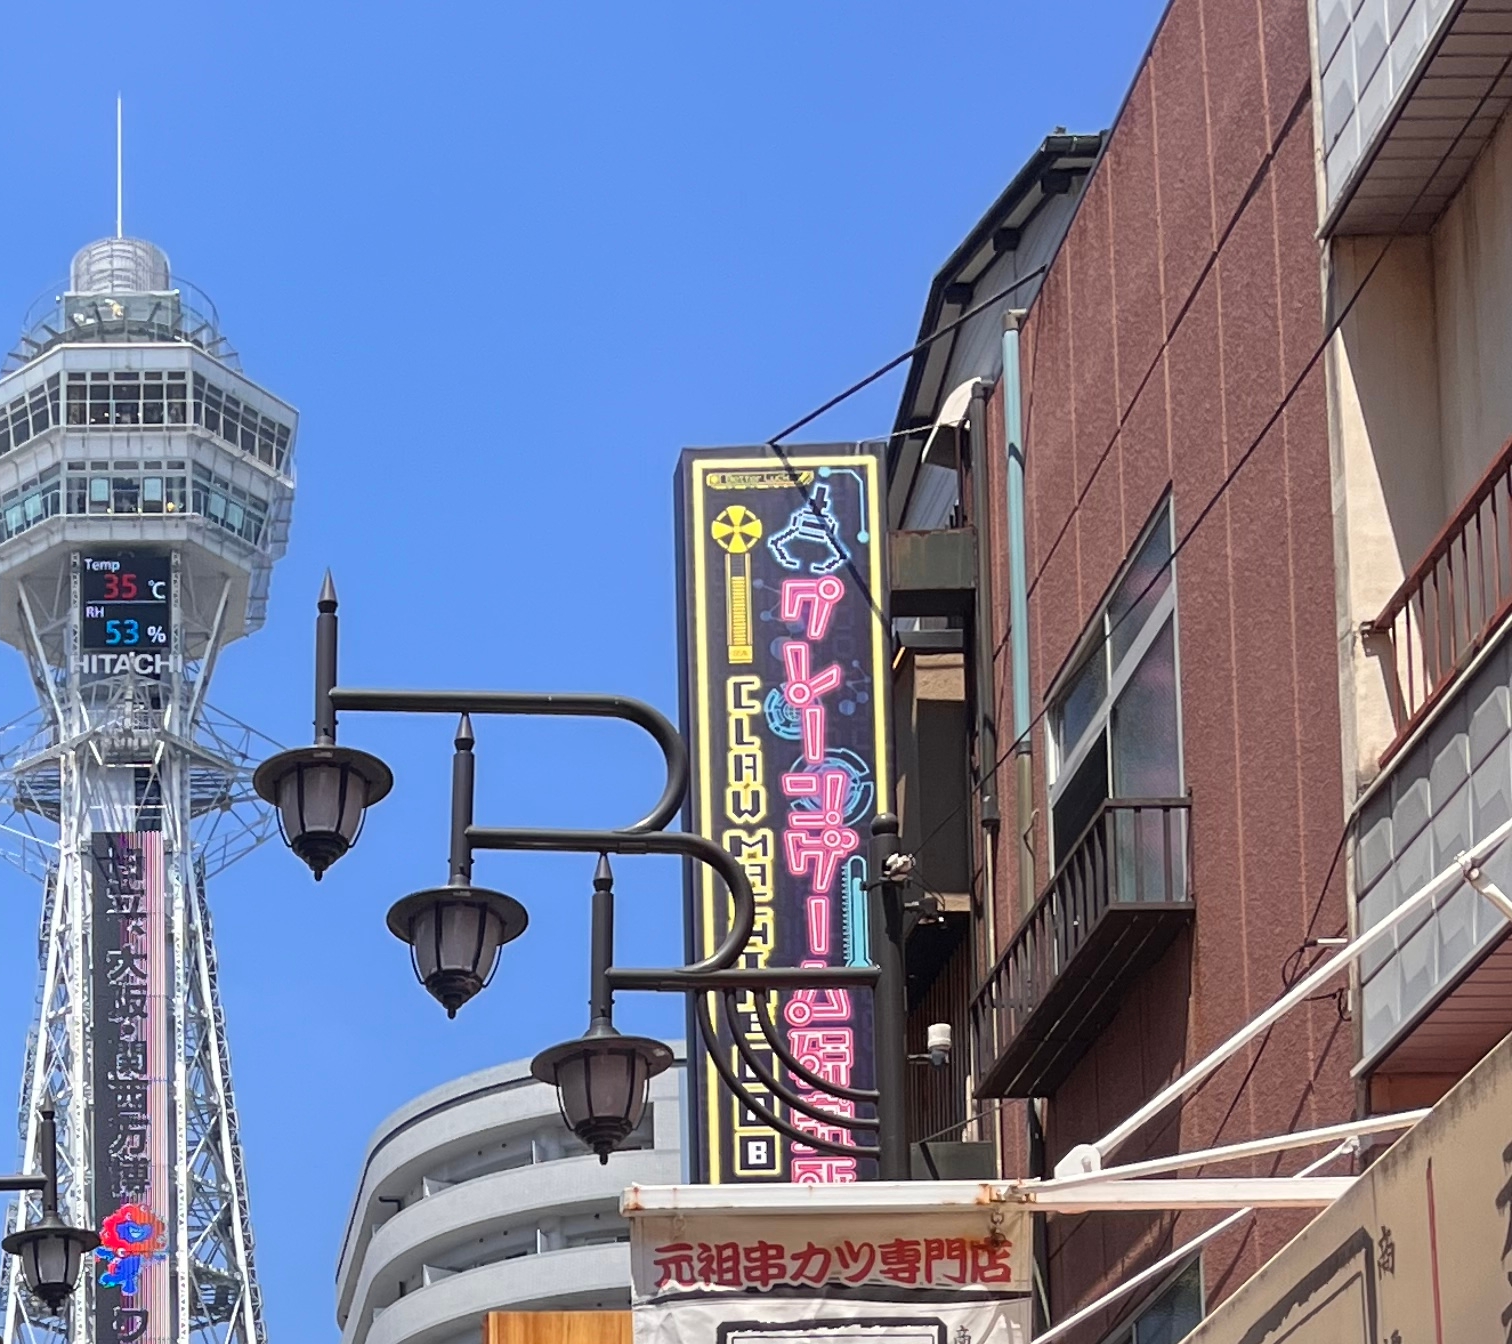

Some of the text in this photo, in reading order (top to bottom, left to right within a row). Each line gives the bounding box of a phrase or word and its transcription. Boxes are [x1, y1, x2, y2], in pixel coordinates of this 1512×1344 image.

[84, 558, 121, 573] Temp
[103, 574, 138, 600] 35
[86, 607, 105, 618] RH
[105, 619, 167, 645] 53 %
[70, 653, 183, 675] HITACHI
[726, 675, 768, 823] CLAW
[653, 1237, 1015, 1288] 元祖串カツ専門店
